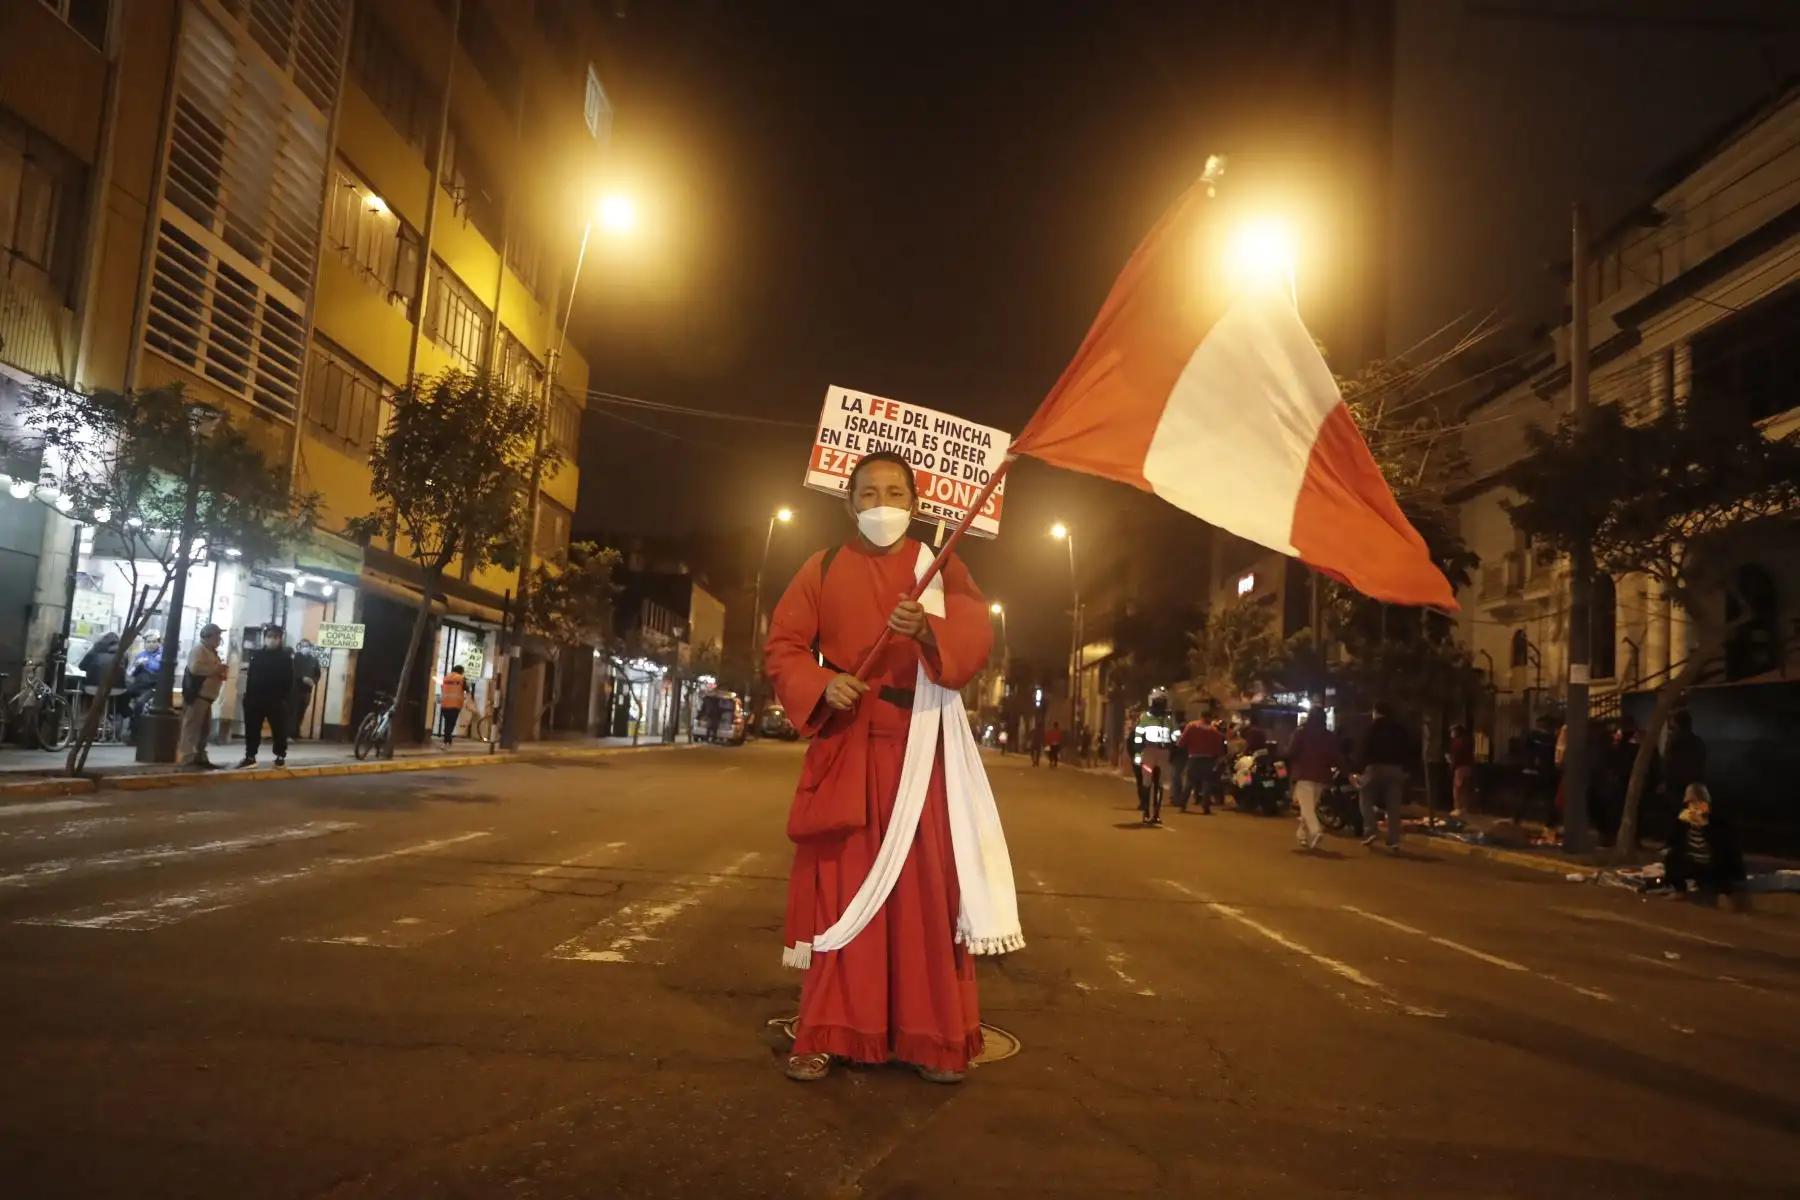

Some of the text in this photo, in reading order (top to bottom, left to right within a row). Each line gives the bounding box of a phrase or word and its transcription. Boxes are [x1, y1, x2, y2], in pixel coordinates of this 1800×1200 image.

[841, 395, 992, 449] LA FE DEL HINCHA
[844, 415, 986, 466] ISRAELITA ES CREER
[820, 427, 841, 446] EN
[845, 433, 861, 451] EL
[866, 437, 936, 469] ENVIADO
[940, 457, 959, 477] DE
[322, 639, 359, 647] ESCANEO
[326, 631, 356, 641] COPIAS
